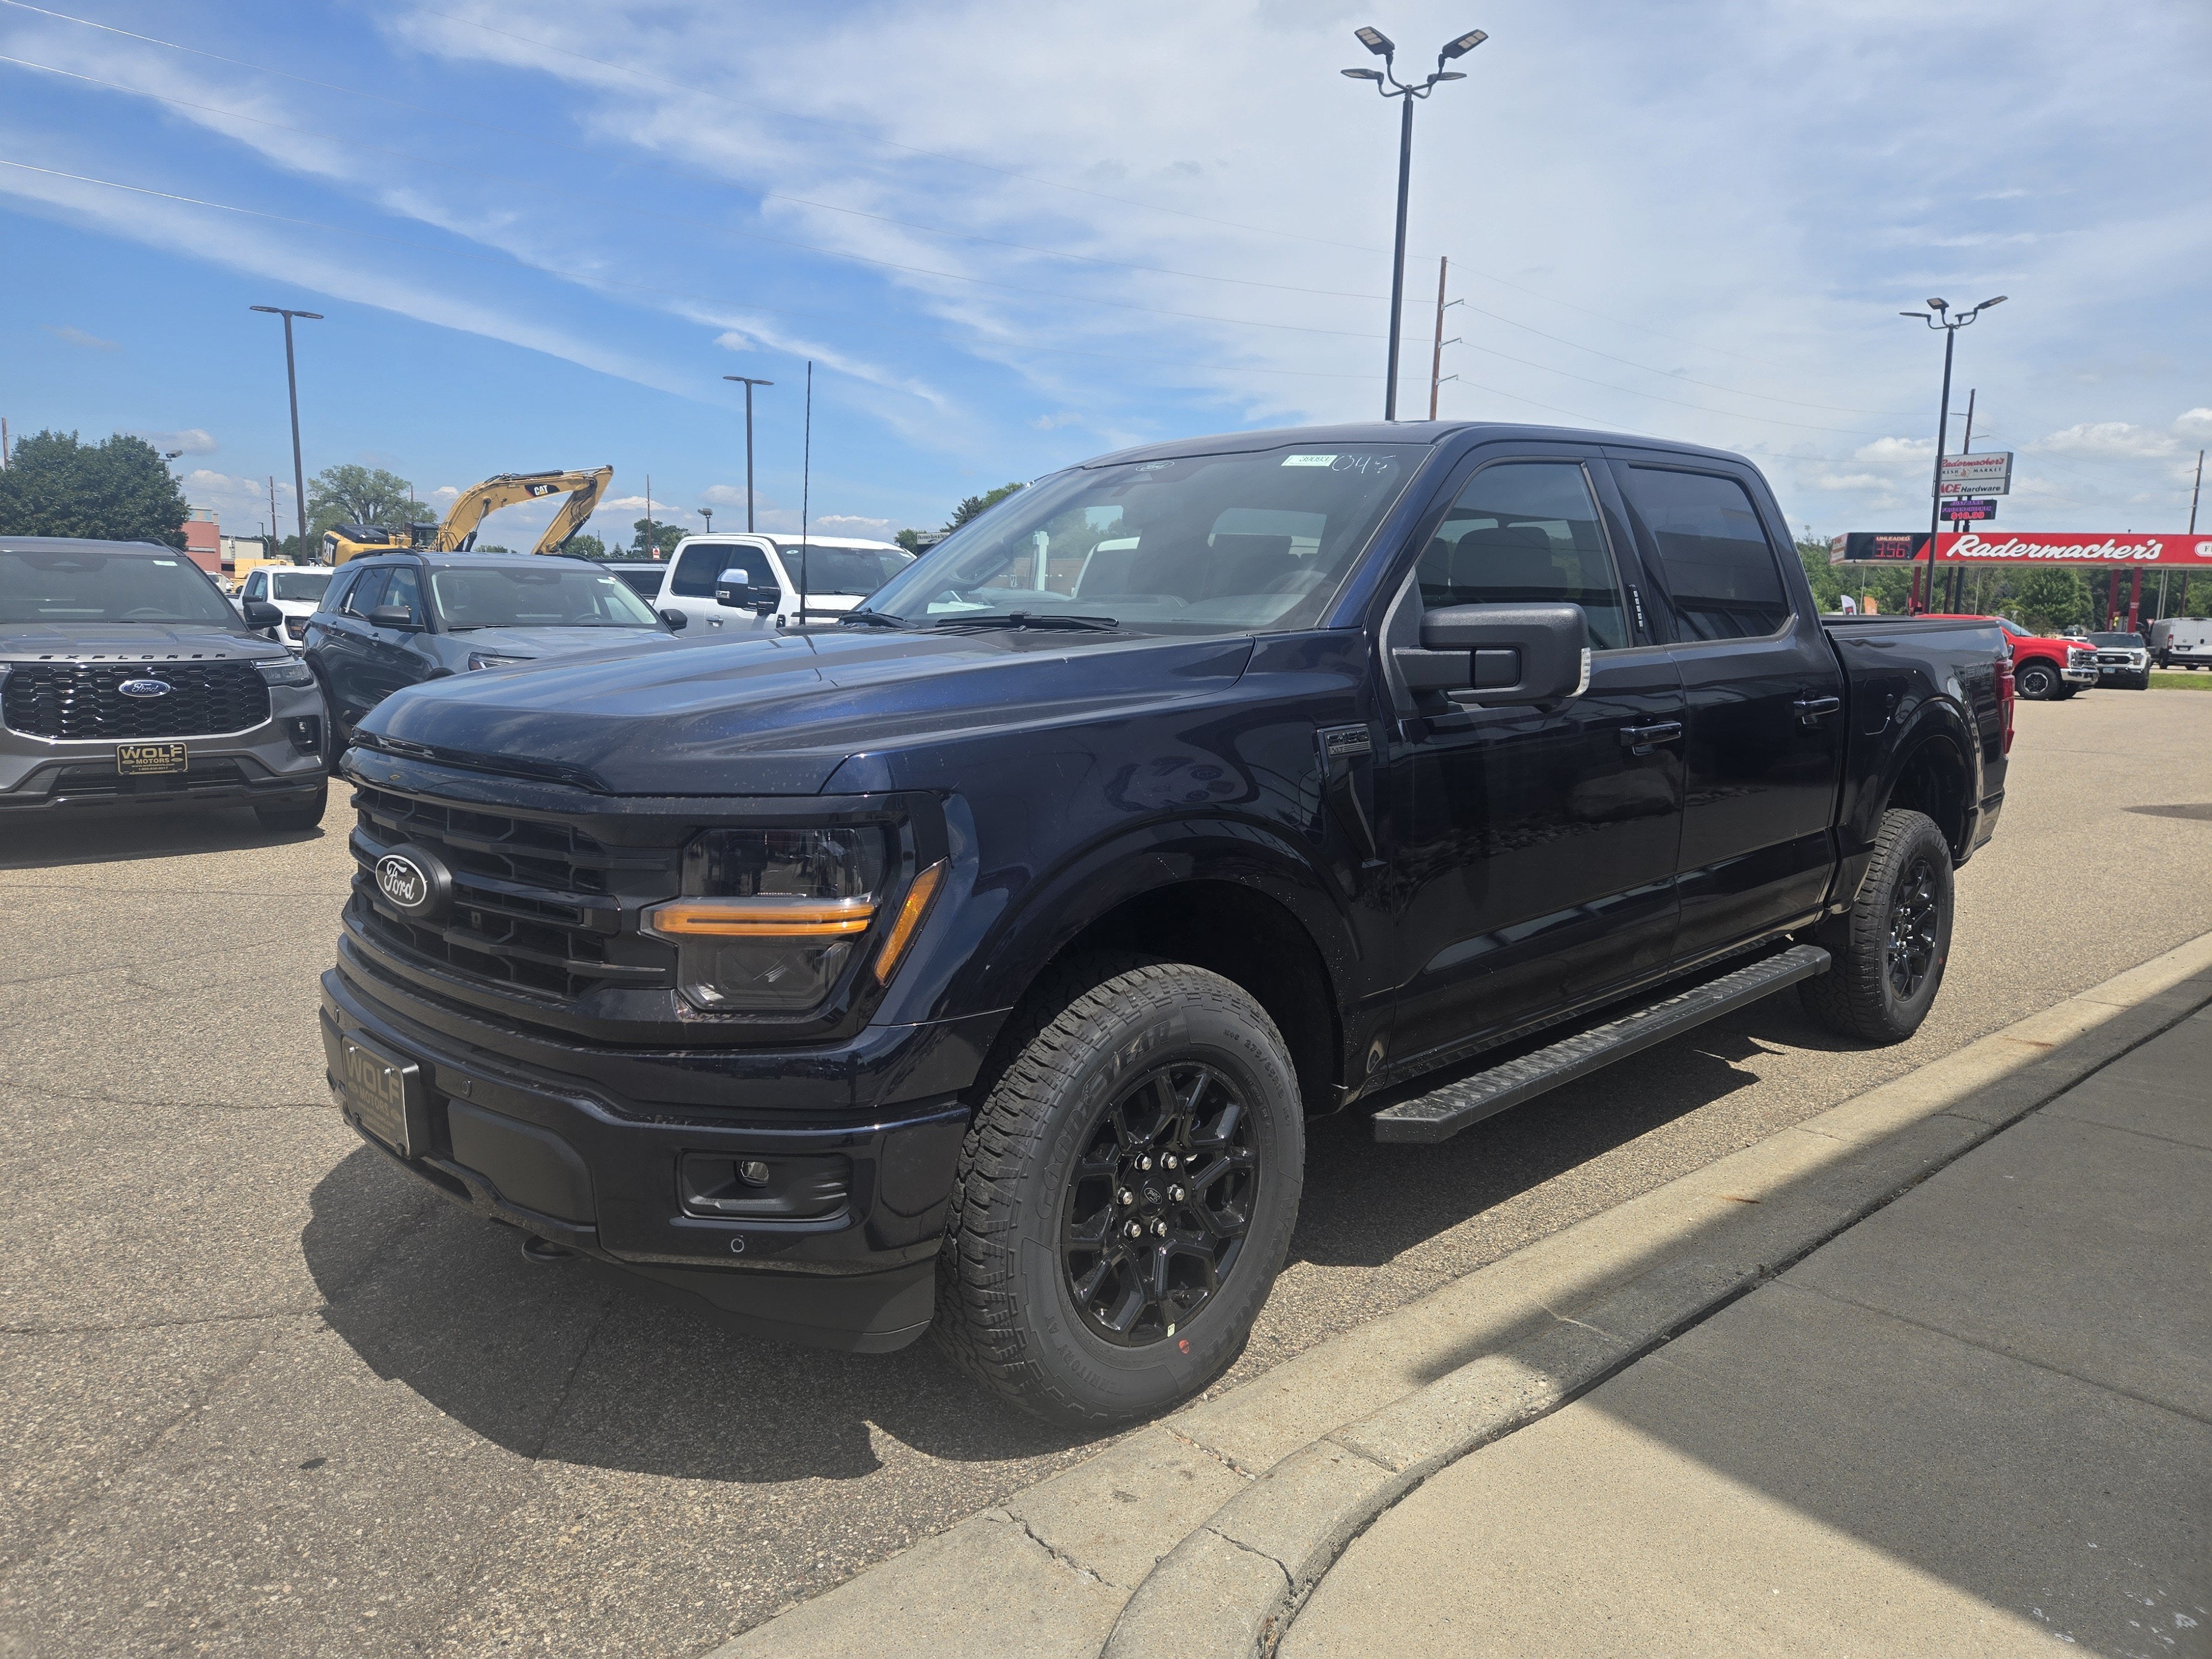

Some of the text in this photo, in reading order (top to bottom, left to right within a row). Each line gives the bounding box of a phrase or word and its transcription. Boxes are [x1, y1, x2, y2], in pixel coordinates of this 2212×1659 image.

[1942, 457, 2005, 468] Radermacher's
[534, 484, 548, 496] CAT
[1946, 534, 2163, 560] Radermacher's
[121, 747, 182, 759] WOLF
[384, 860, 415, 900] Ford
[345, 1048, 399, 1104] WOLF
[359, 1086, 390, 1117] MOTORS
[1036, 1020, 1171, 1219] GOODYEAR
[1044, 1316, 1059, 1334] AT
